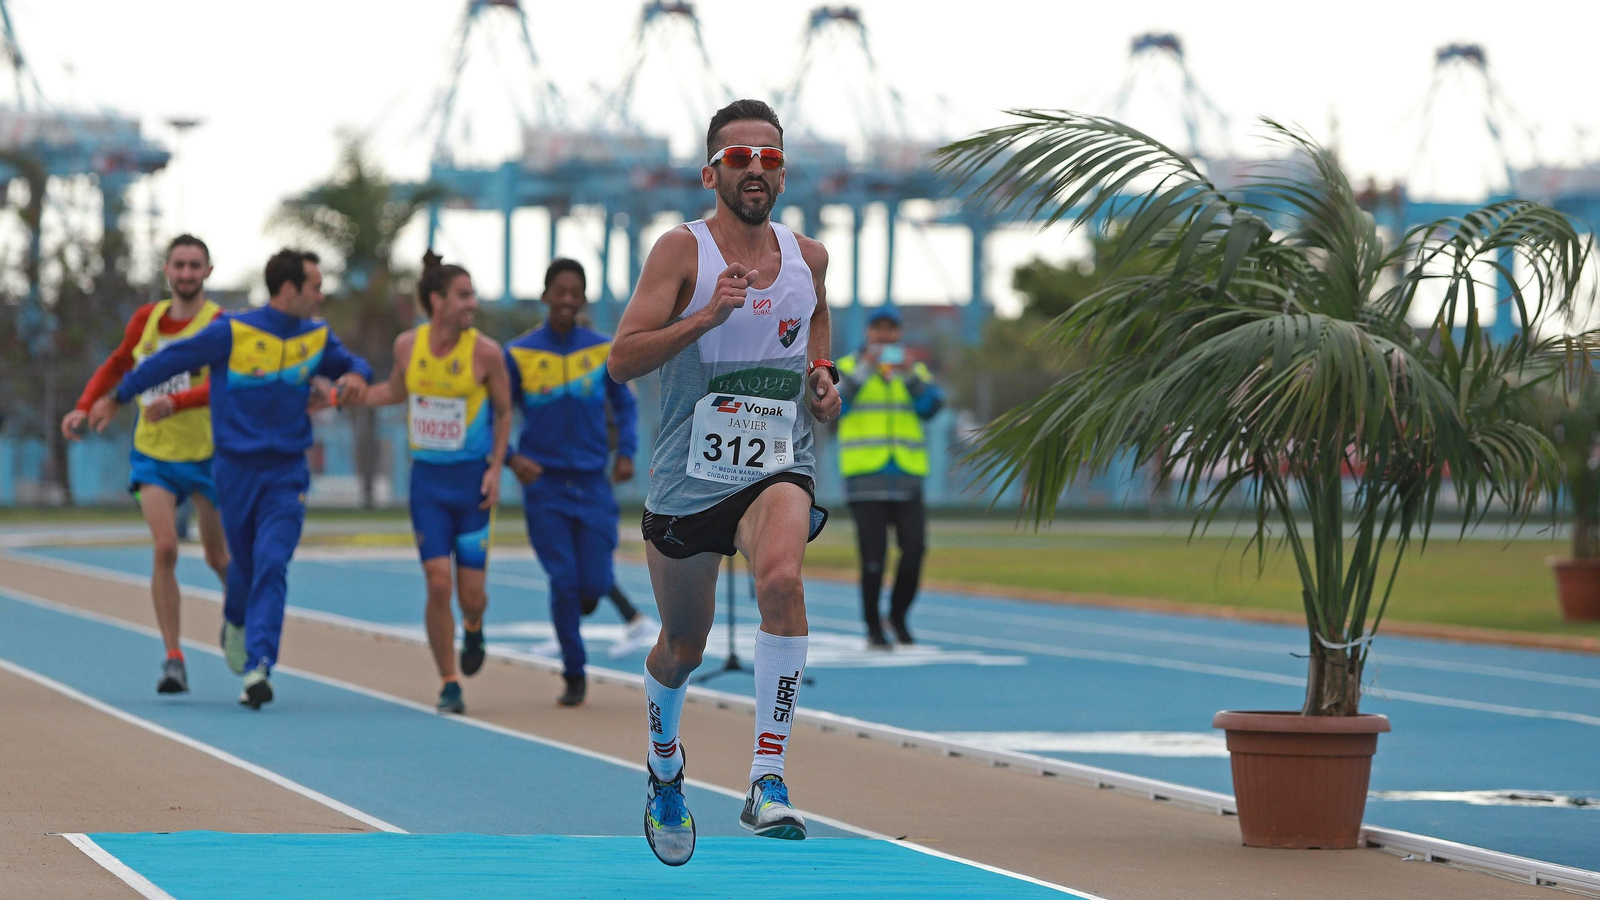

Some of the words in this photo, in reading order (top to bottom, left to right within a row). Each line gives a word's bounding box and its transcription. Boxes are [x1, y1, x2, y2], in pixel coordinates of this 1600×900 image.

[719, 376, 792, 393] BAQUE
[744, 402, 783, 417] Vopak
[728, 418, 767, 431] JAVIER
[702, 433, 766, 468] 312
[706, 471, 729, 480] CIUDAD
[718, 466, 737, 474] MEDIA
[773, 670, 800, 723] SURAL
